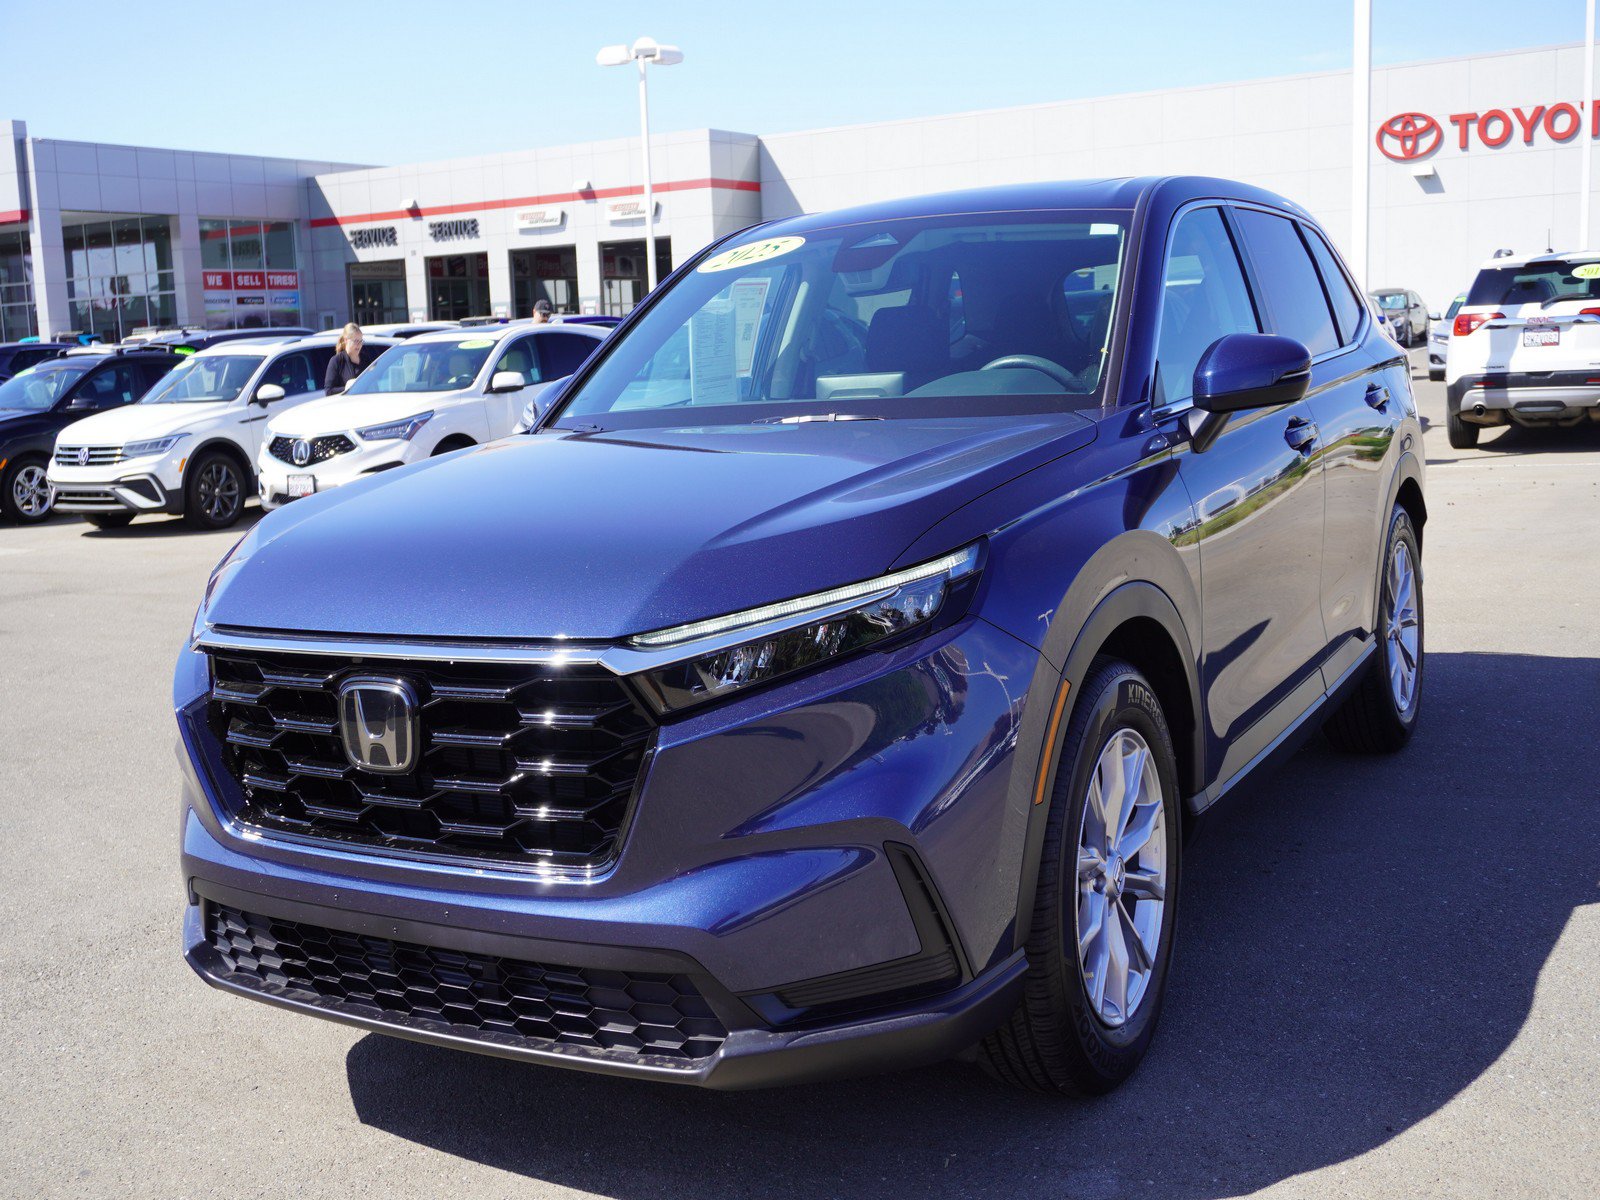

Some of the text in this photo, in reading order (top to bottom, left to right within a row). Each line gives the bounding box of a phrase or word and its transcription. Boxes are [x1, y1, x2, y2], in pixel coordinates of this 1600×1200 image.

[350, 226, 398, 249] SERVICE
[428, 218, 479, 241] SERVICE
[207, 274, 297, 286] WE SELL TIRES!
